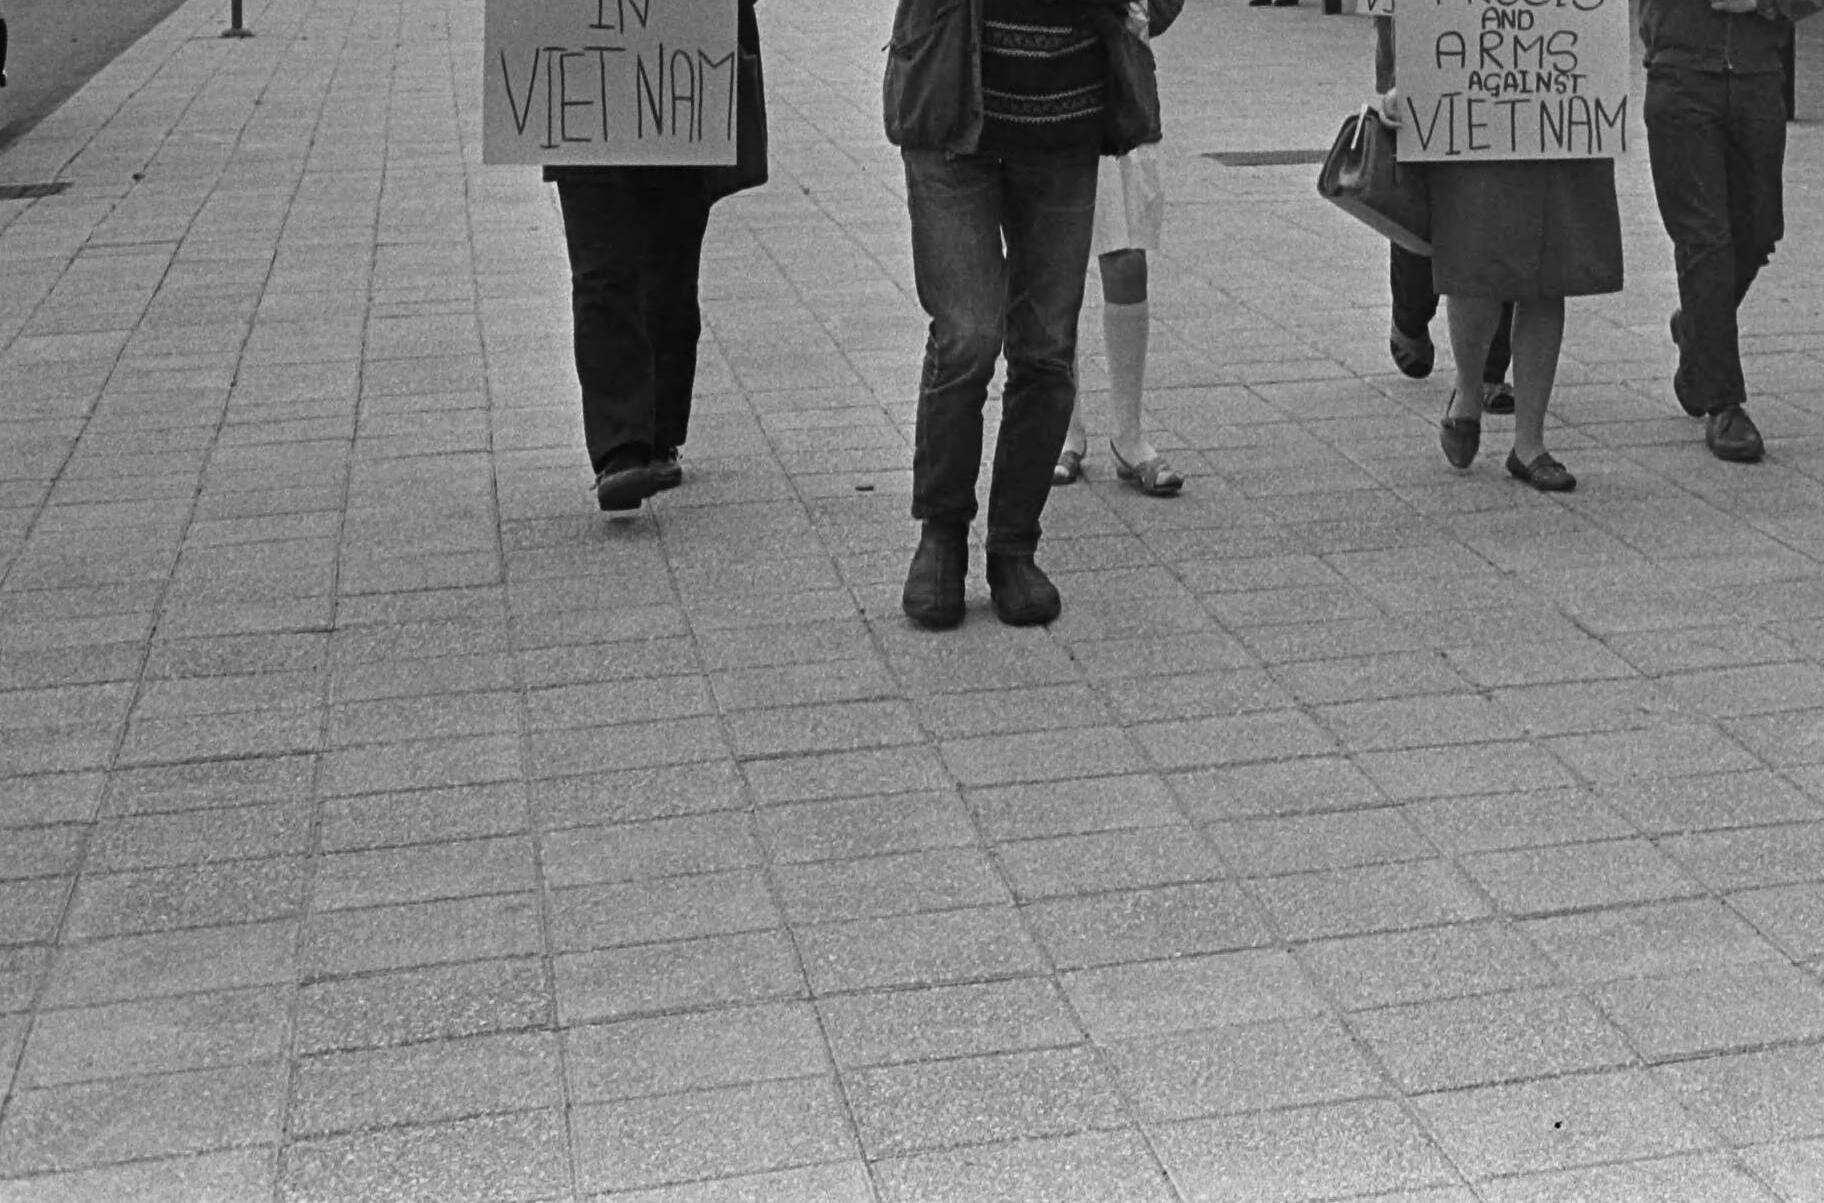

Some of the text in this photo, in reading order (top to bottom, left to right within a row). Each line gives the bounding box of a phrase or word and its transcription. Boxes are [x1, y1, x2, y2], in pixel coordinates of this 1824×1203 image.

[1481, 8, 1535, 31] AND
[1436, 30, 1578, 73] ARMS
[500, 42, 735, 148] VIETNAM
[1468, 69, 1587, 96] AGAINST
[1406, 92, 1628, 156] VIETNAM
